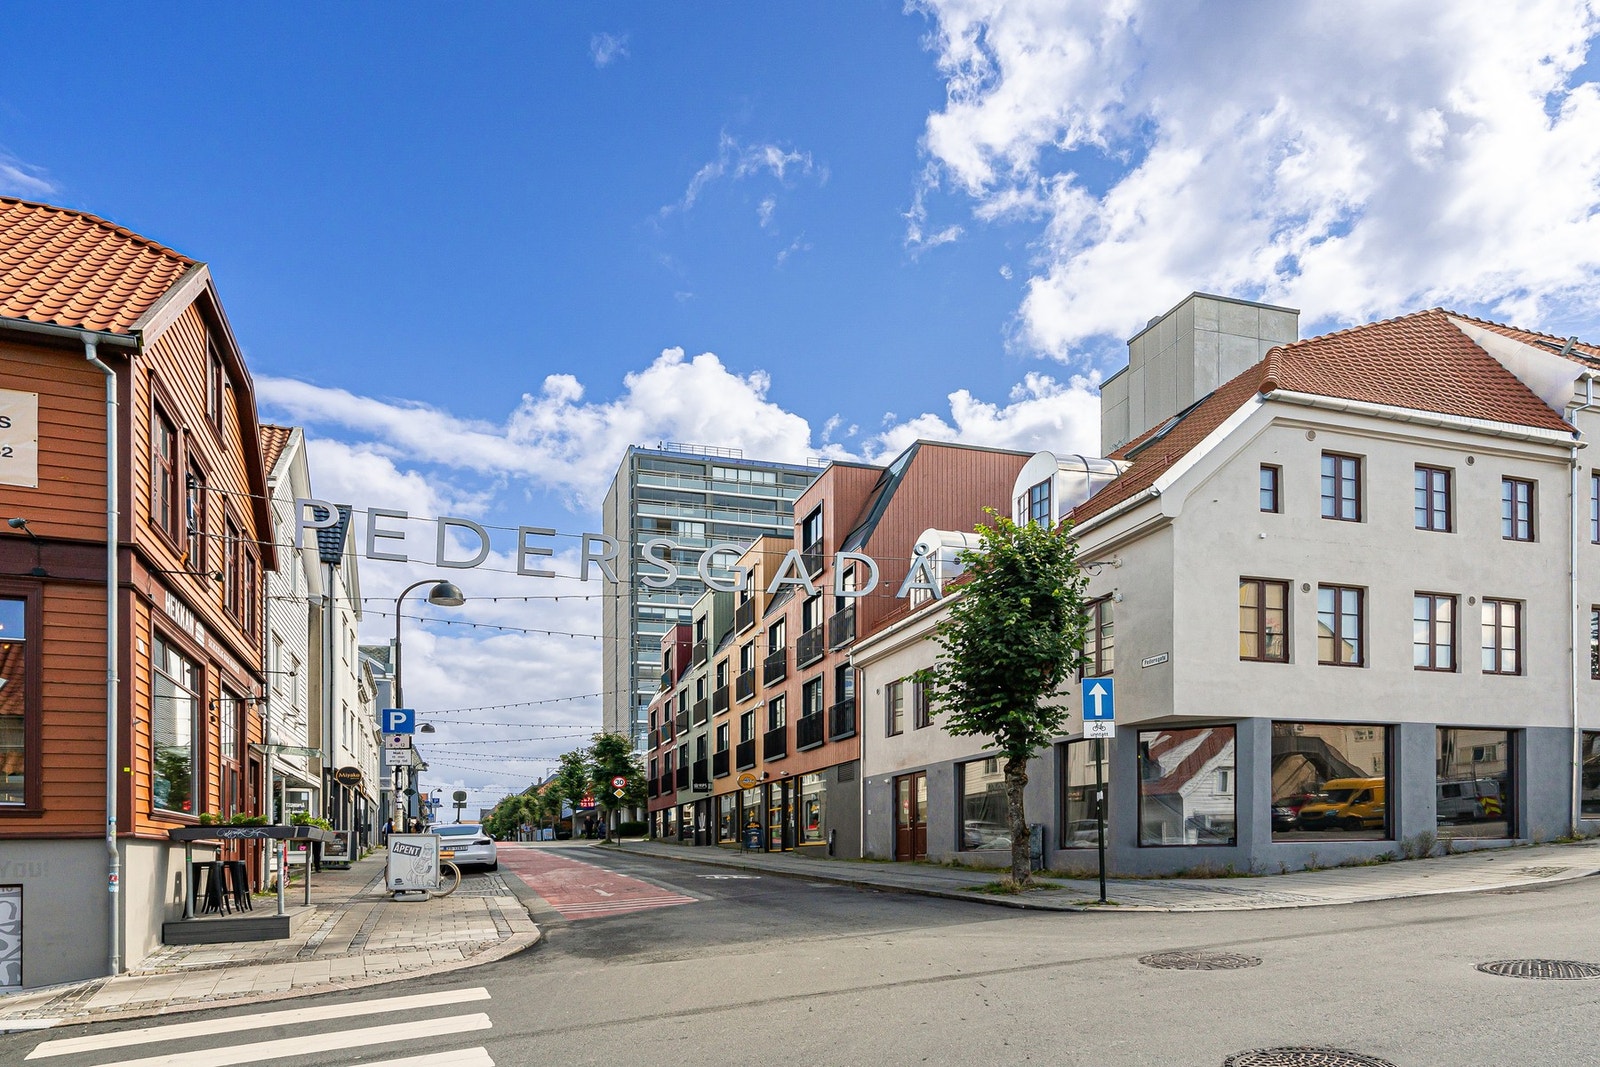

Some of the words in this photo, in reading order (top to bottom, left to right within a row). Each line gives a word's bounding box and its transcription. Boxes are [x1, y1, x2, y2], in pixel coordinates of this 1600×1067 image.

[294, 497, 943, 601] PEDERSGADÅ
[390, 712, 406, 730] P
[394, 841, 421, 857] ÅPENT
